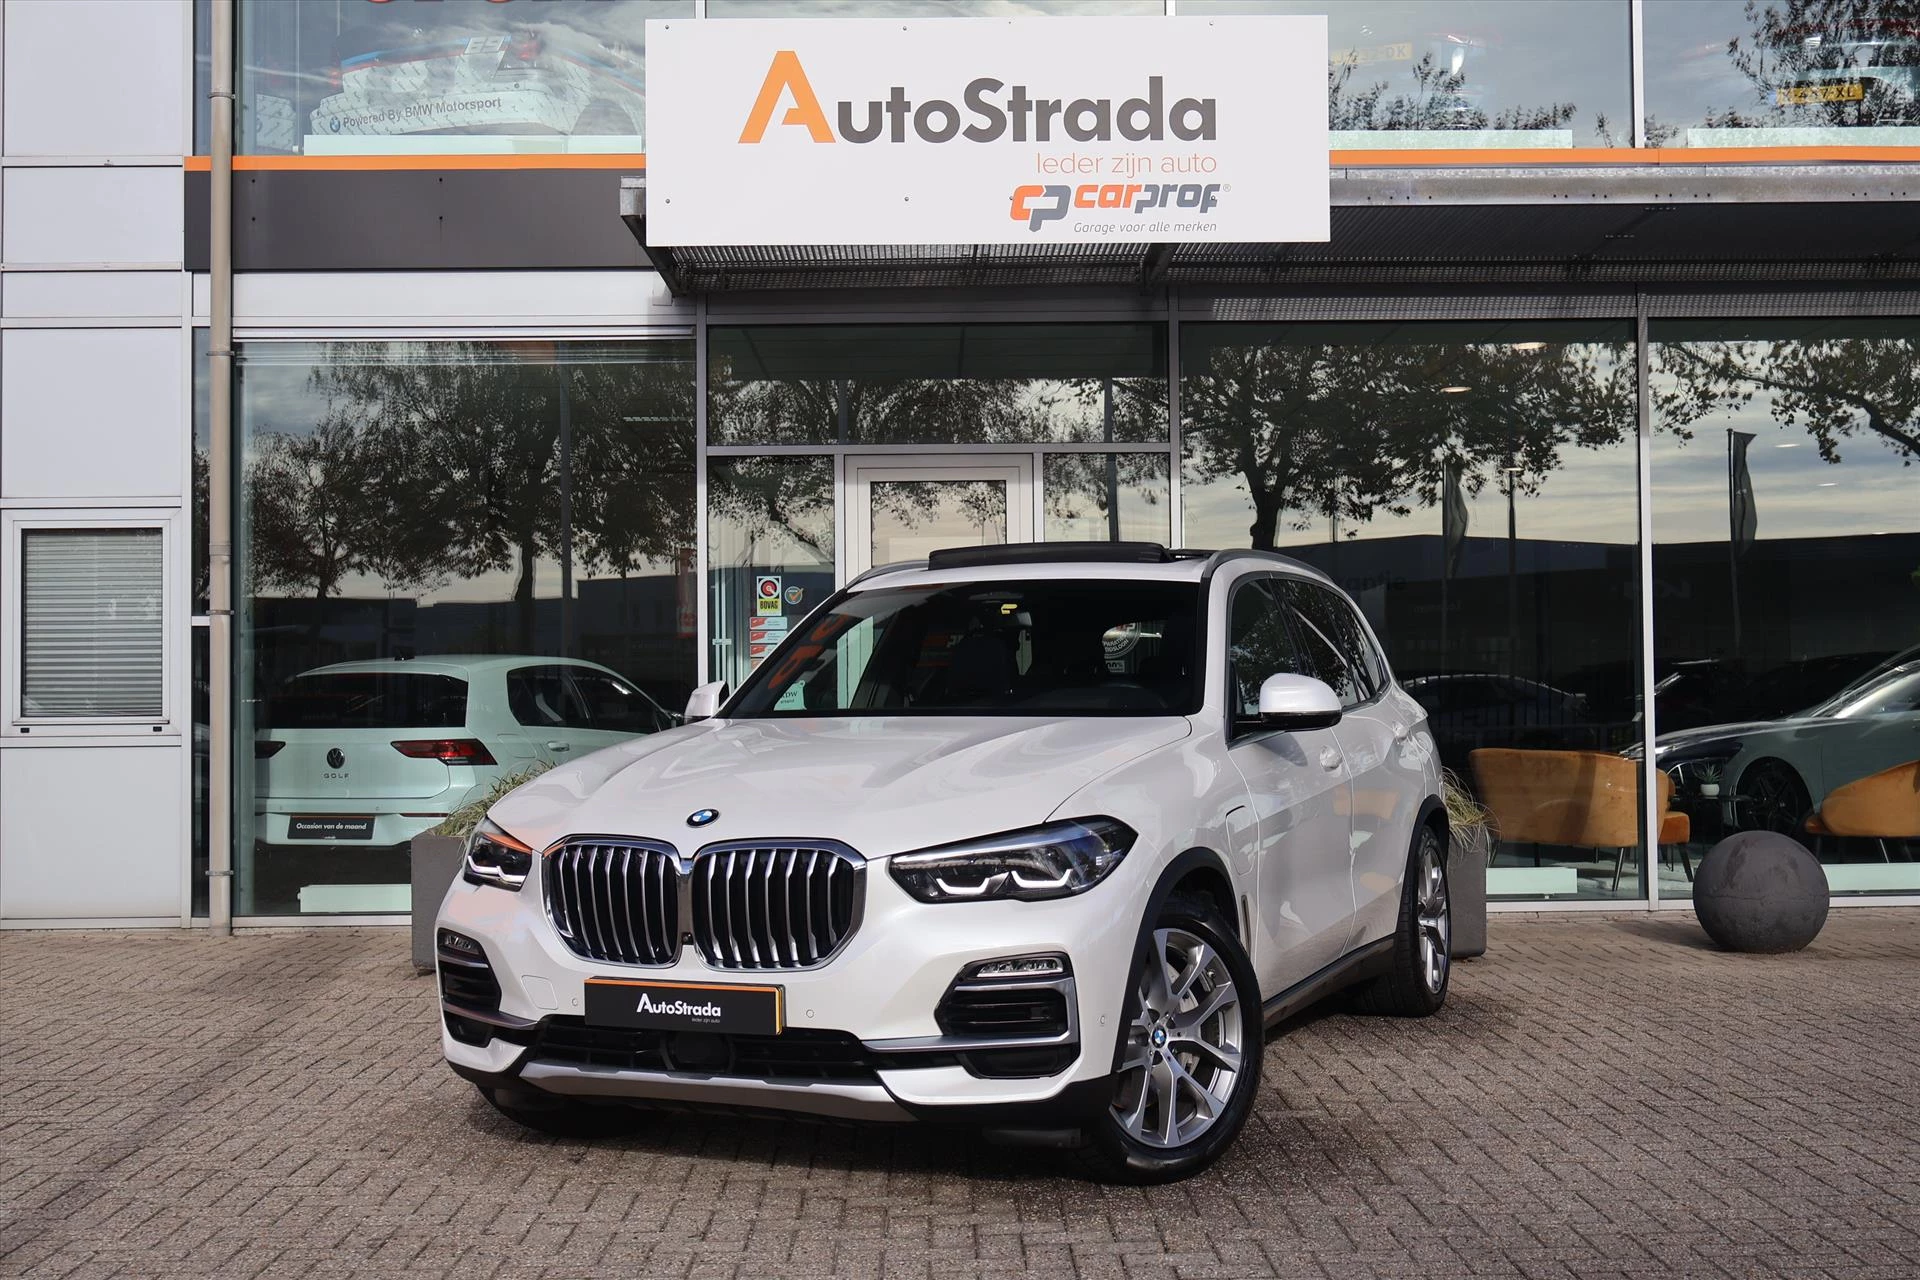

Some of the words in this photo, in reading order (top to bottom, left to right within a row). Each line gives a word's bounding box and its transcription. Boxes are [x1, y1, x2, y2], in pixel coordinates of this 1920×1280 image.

[738, 50, 1217, 144] AutoStrada
[342, 113, 385, 128] Powered
[388, 109, 402, 122] By
[405, 104, 434, 118] BMW
[436, 96, 502, 114] Motorsport
[1037, 152, 1104, 174] Ieder
[1111, 152, 1152, 179] zijn
[1160, 153, 1217, 174] auto
[1073, 222, 1116, 236] Garage
[1119, 223, 1146, 233] voor
[1148, 221, 1171, 232] alle
[1173, 221, 1217, 232] merken
[295, 822, 323, 830] Occasion
[335, 822, 344, 830] de
[636, 992, 722, 1017] AutoStrada
